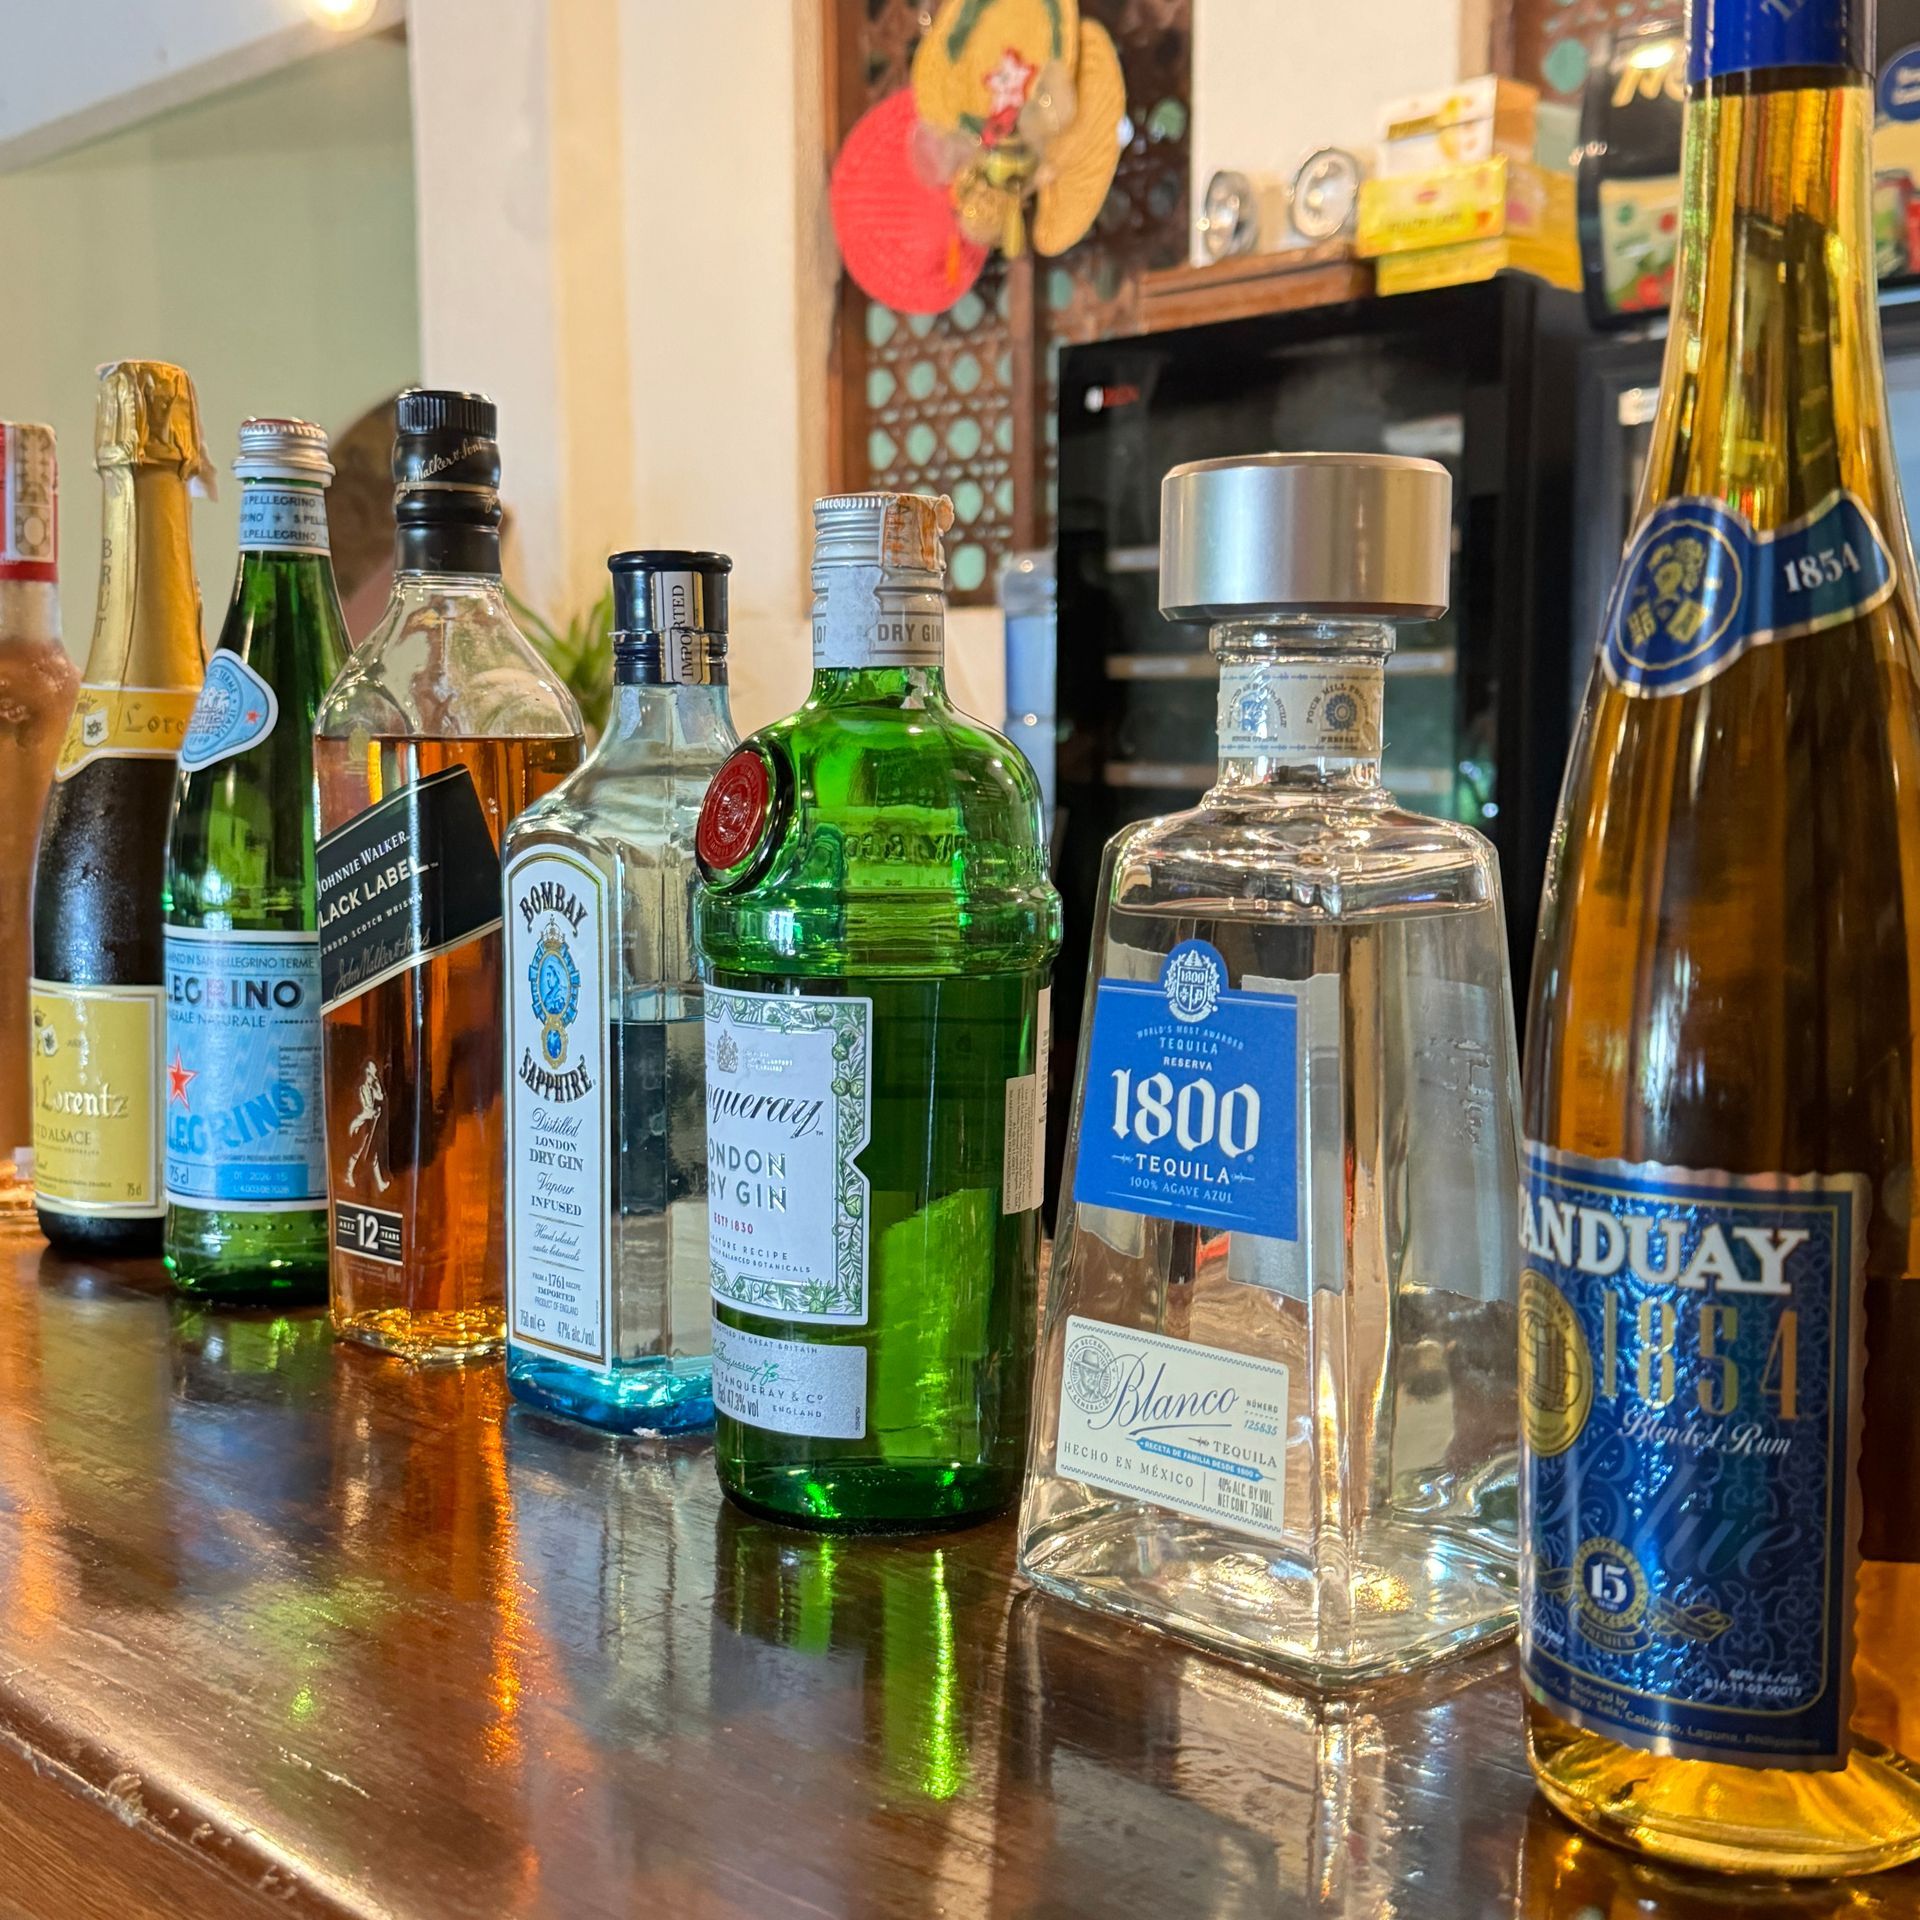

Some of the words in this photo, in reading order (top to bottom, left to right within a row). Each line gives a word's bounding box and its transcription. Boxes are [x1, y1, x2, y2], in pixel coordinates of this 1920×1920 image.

[1783, 541, 1862, 594] 1854
[877, 623, 916, 643] DRY
[317, 858, 362, 900] JOHNNIE
[360, 830, 408, 867] WALKER
[364, 856, 430, 900] LABEL
[352, 915, 383, 937] SCOTCH
[386, 893, 424, 918] WHISKY
[519, 881, 588, 938] BOMBAY
[281, 957, 315, 969] TERME
[1181, 971, 1204, 983] 1800
[1159, 1036, 1219, 1056] TEQUILA
[1176, 1025, 1200, 1035] MOST
[1203, 1029, 1245, 1051] AWARDED
[519, 1046, 593, 1104] SAPPHIRE
[1163, 1055, 1213, 1072] RESERVA
[41, 1076, 129, 1118] Lorentz
[530, 1107, 584, 1138] Distilled
[1111, 1067, 1261, 1159] 1800
[535, 1135, 578, 1152] LONDON
[528, 1148, 556, 1167] DRY
[558, 1153, 585, 1172] GIN
[708, 1137, 786, 1180] ONDON
[1135, 1153, 1230, 1185] TEQUILA
[536, 1171, 575, 1197] Vapour
[709, 1170, 727, 1201] RY
[735, 1180, 787, 1213] GIN
[1130, 1176, 1159, 1191] 100%
[1162, 1182, 1200, 1198] AGAVE
[1203, 1189, 1234, 1204] AZUL
[531, 1195, 582, 1217] INFUSED
[338, 1220, 356, 1231] AGED
[357, 1212, 379, 1250] 12
[380, 1231, 400, 1242] YEARS
[730, 1219, 755, 1235] 1830
[742, 1245, 789, 1261] RECIPE
[752, 1260, 812, 1273] BOTANICALS
[537, 1286, 576, 1303] IMPORTED
[548, 1273, 566, 1290] 1761
[738, 1334, 747, 1342] IN
[748, 1337, 775, 1351] GREAT
[777, 1343, 818, 1355] BRITAIN
[1601, 1289, 1801, 1420] 1854
[721, 1371, 785, 1400] TANQUERAY
[1087, 1351, 1240, 1431] Blanco
[772, 1404, 823, 1418] ENGLAND
[1246, 1398, 1279, 1414] NÚMERO
[1617, 1411, 1722, 1449] Blended
[1721, 1422, 1792, 1456] Rum
[1063, 1440, 1109, 1464] HECHO
[1115, 1456, 1133, 1471] EN
[1140, 1462, 1194, 1488] MÉXICO
[1144, 1441, 1172, 1455] RECETA
[1172, 1449, 1182, 1458] DE
[1183, 1451, 1211, 1467] FAMILIA
[1211, 1460, 1235, 1473] DESDE
[1213, 1440, 1278, 1469] TEQUILA
[1217, 1493, 1230, 1509] NET
[1250, 1502, 1273, 1521] 750ML
[1248, 1485, 1259, 1501] BY
[1589, 1562, 1628, 1606] 15
